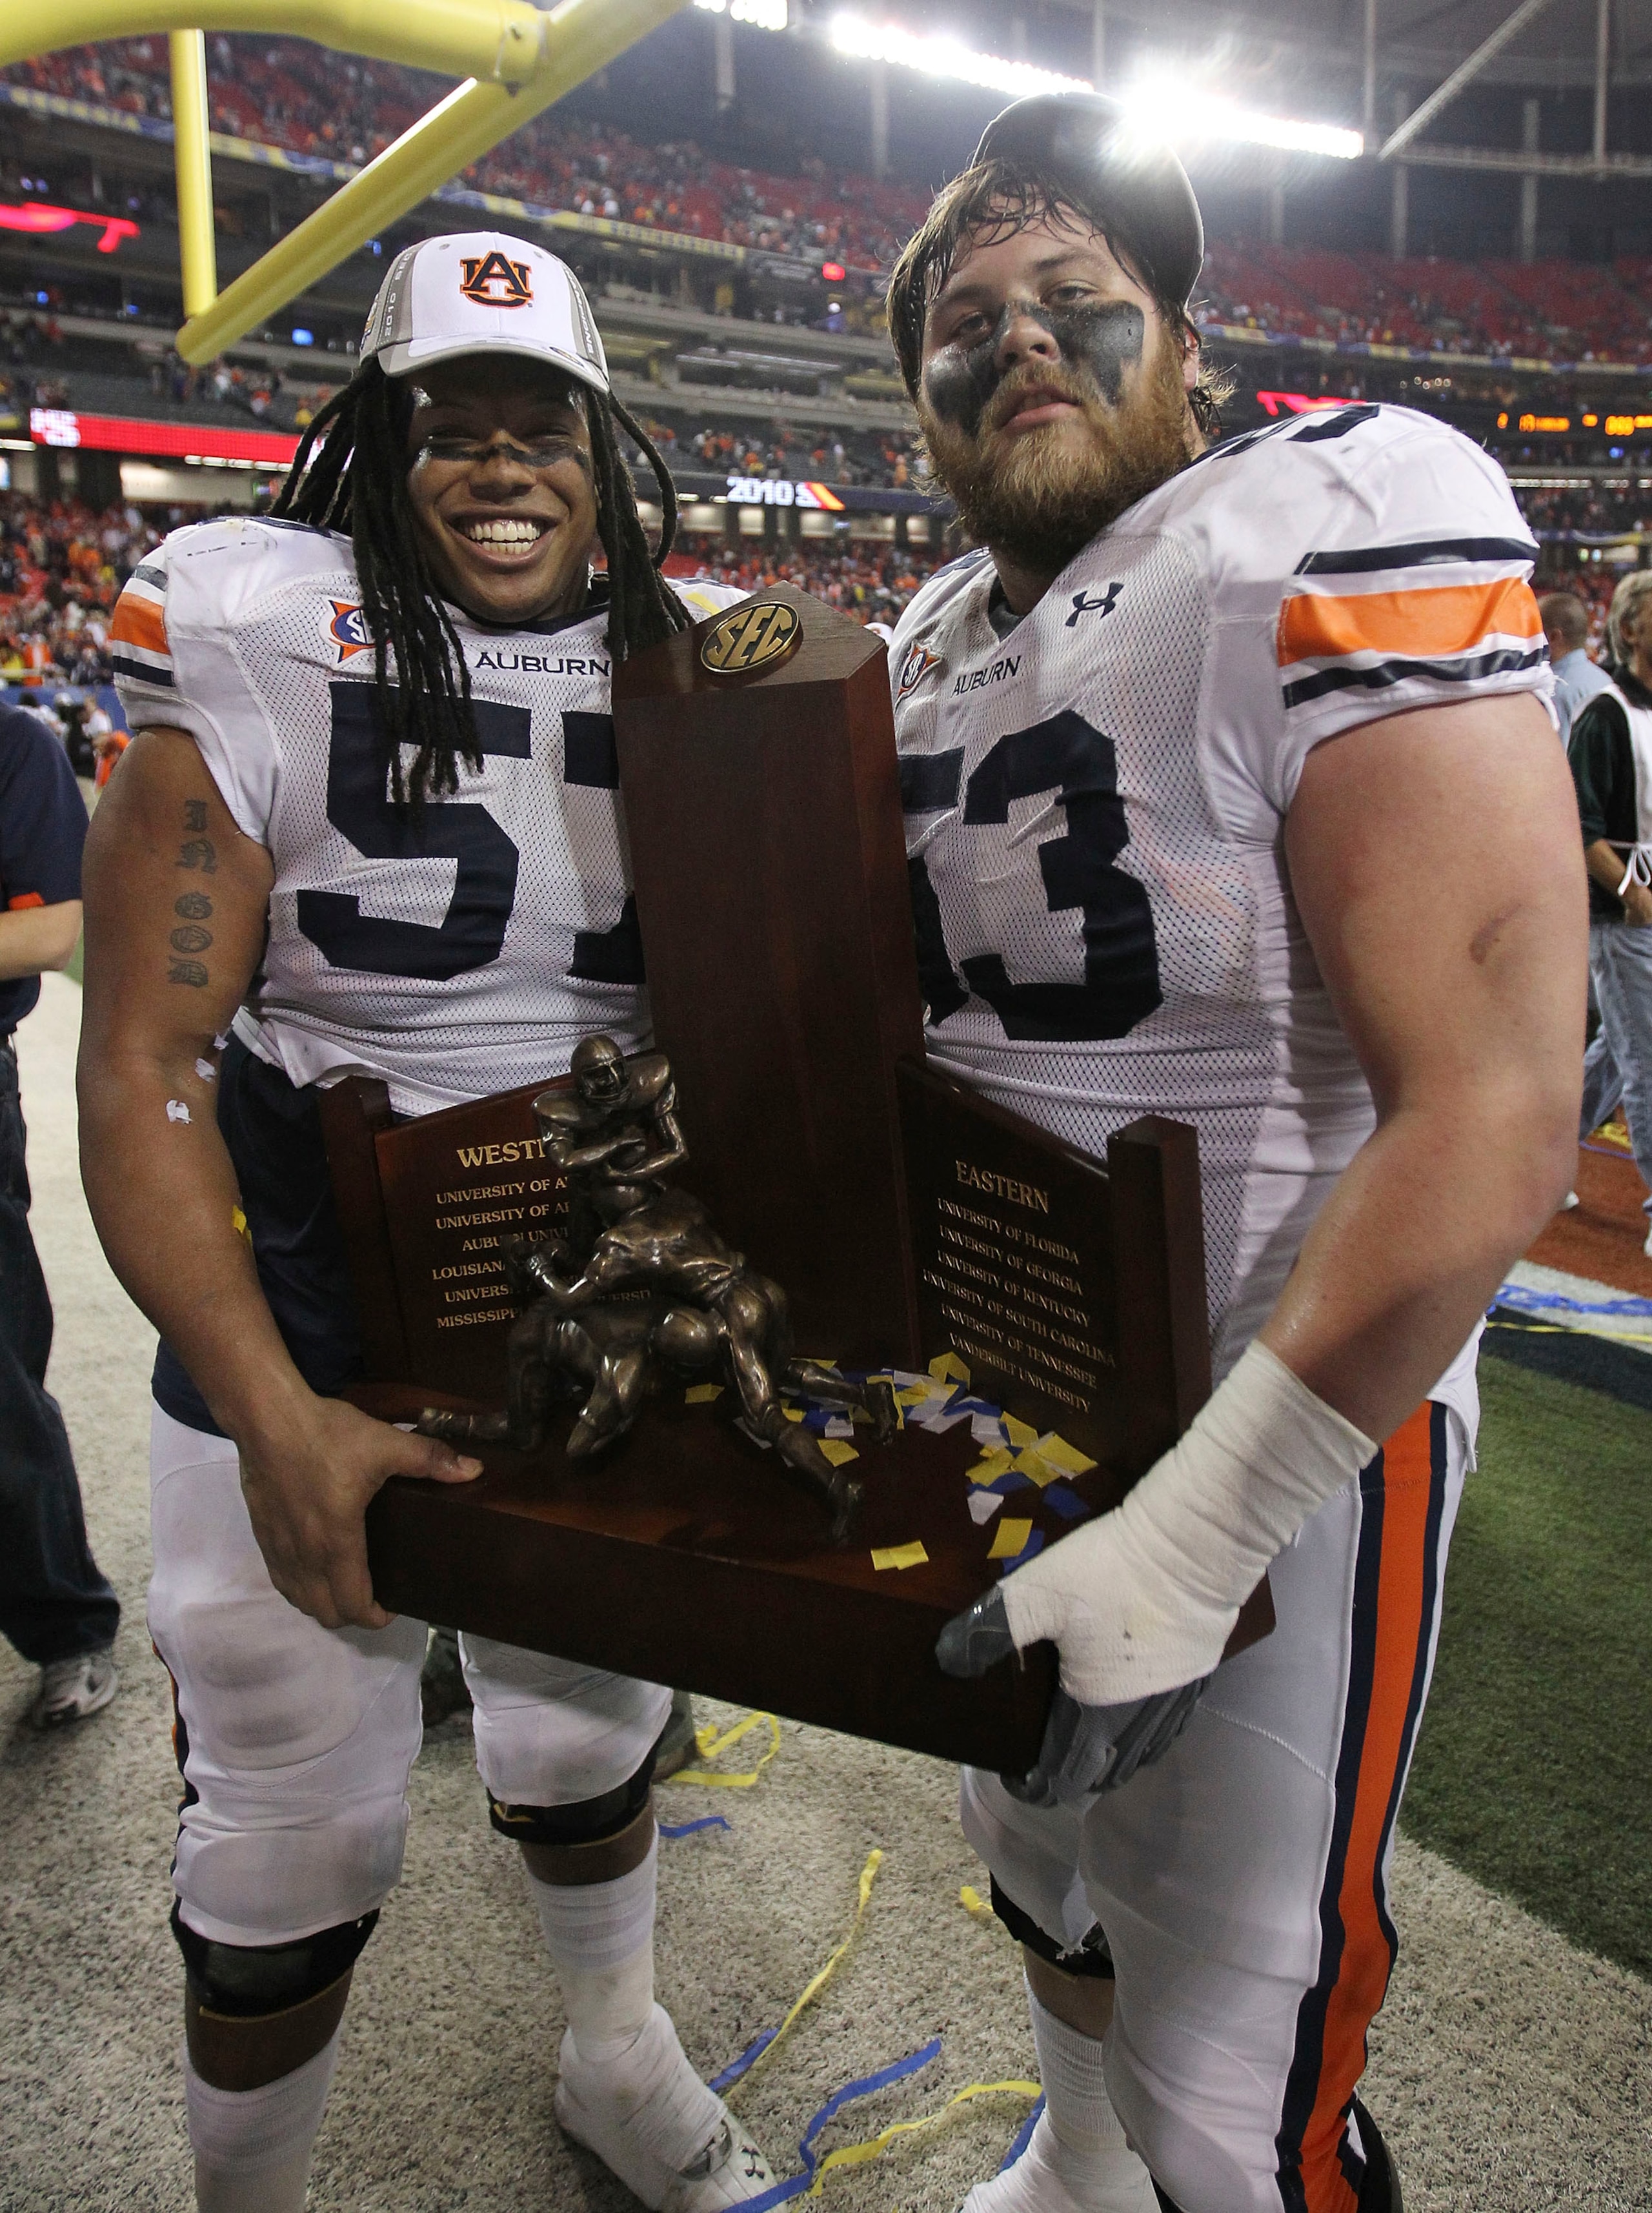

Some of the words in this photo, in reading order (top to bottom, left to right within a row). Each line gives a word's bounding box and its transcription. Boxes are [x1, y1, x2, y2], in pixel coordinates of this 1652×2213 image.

[384, 292, 396, 336] 2010
[727, 476, 794, 506] 2010
[475, 652, 611, 676] AUBURN
[707, 605, 792, 668] SEC
[951, 656, 1021, 698] AUBURN
[436, 1182, 525, 1204] UNIVERSITY
[530, 1178, 550, 1192] OF
[956, 1160, 1049, 1214] EASTERN
[436, 1207, 525, 1229] UNIVERSITY
[529, 1204, 550, 1217] OF
[938, 1197, 1001, 1234] UNIVERSITY
[1005, 1227, 1022, 1241] OF
[1024, 1232, 1079, 1264] FLORIDA
[938, 1250, 1000, 1288] UNIVERSITY
[1004, 1280, 1020, 1296] OF
[1023, 1288, 1090, 1328] KENTUCKY
[940, 1224, 1003, 1262] UNIVERSITY
[1007, 1253, 1023, 1269] OF
[1026, 1262, 1083, 1296] GEORGIA
[923, 1269, 984, 1307] UNIVERSITY
[987, 1299, 1003, 1315] OF
[1005, 1309, 1047, 1338] SOUTH
[1050, 1329, 1116, 1368] CAROLINA
[941, 1303, 1004, 1343] UNIVERSITY
[1007, 1336, 1023, 1352] OF
[1026, 1343, 1096, 1389] TENNESSEE
[950, 1332, 1016, 1375] VANDERBILT
[1018, 1368, 1091, 1414] UNIVERSITY
